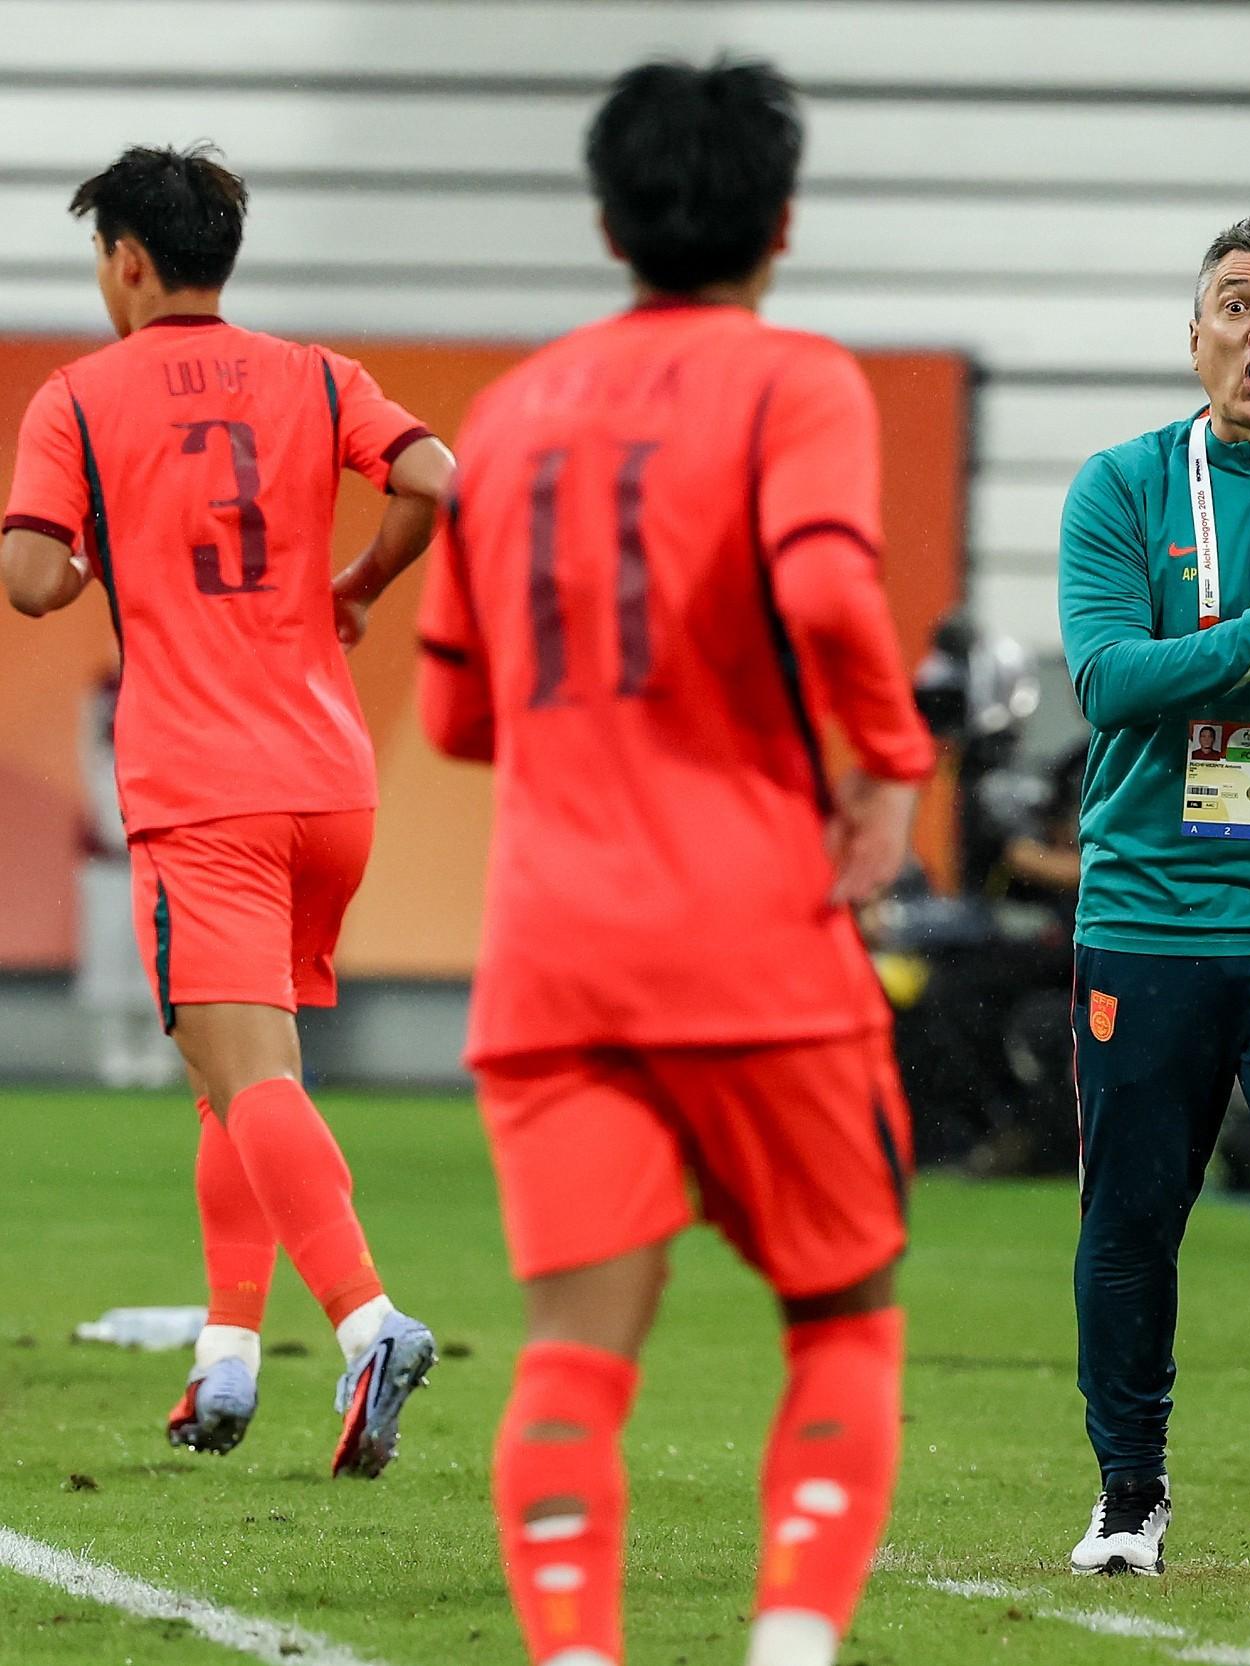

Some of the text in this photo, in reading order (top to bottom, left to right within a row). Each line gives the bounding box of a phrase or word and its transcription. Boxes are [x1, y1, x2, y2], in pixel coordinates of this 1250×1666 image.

[163, 359, 206, 396] LIU
[171, 420, 279, 595] 3
[1197, 490, 1206, 510] 2026
[1200, 511, 1212, 570] Aichi-Nagoya
[527, 440, 662, 708] 11
[1182, 567, 1197, 581] AP
[1191, 825, 1231, 835] A 2
